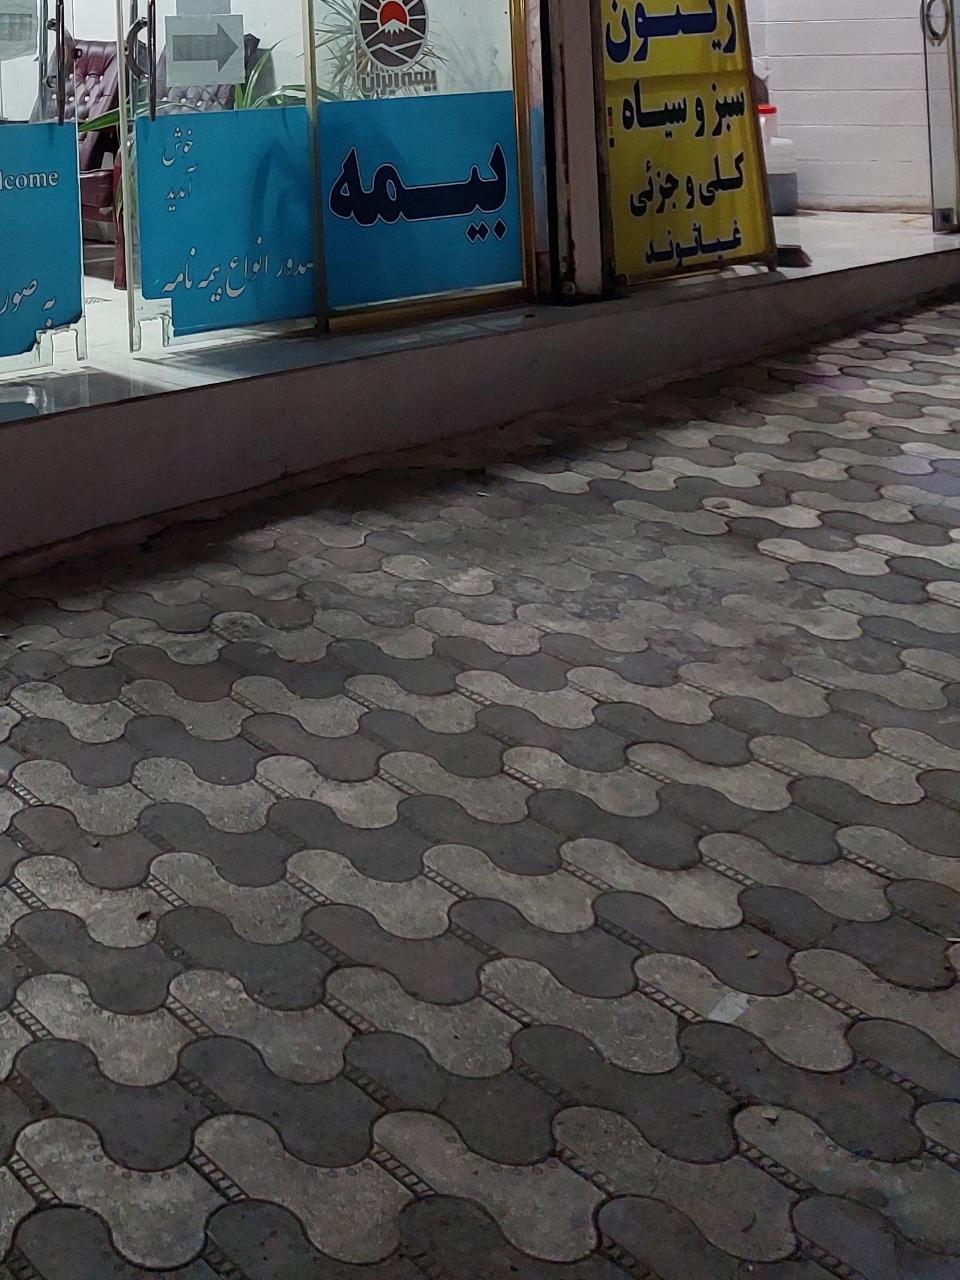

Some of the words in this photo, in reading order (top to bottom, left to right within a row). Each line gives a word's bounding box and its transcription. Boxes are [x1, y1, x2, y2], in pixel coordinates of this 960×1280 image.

[620, 78, 688, 140] سیاه
[694, 94, 707, 138] و
[710, 81, 746, 137] سبز
[161, 125, 194, 168] خوش
[328, 142, 509, 244] بیمه
[684, 172, 696, 211] و
[698, 151, 746, 207] کلی
[161, 246, 197, 293] نامه
[224, 234, 269, 298] انواع
